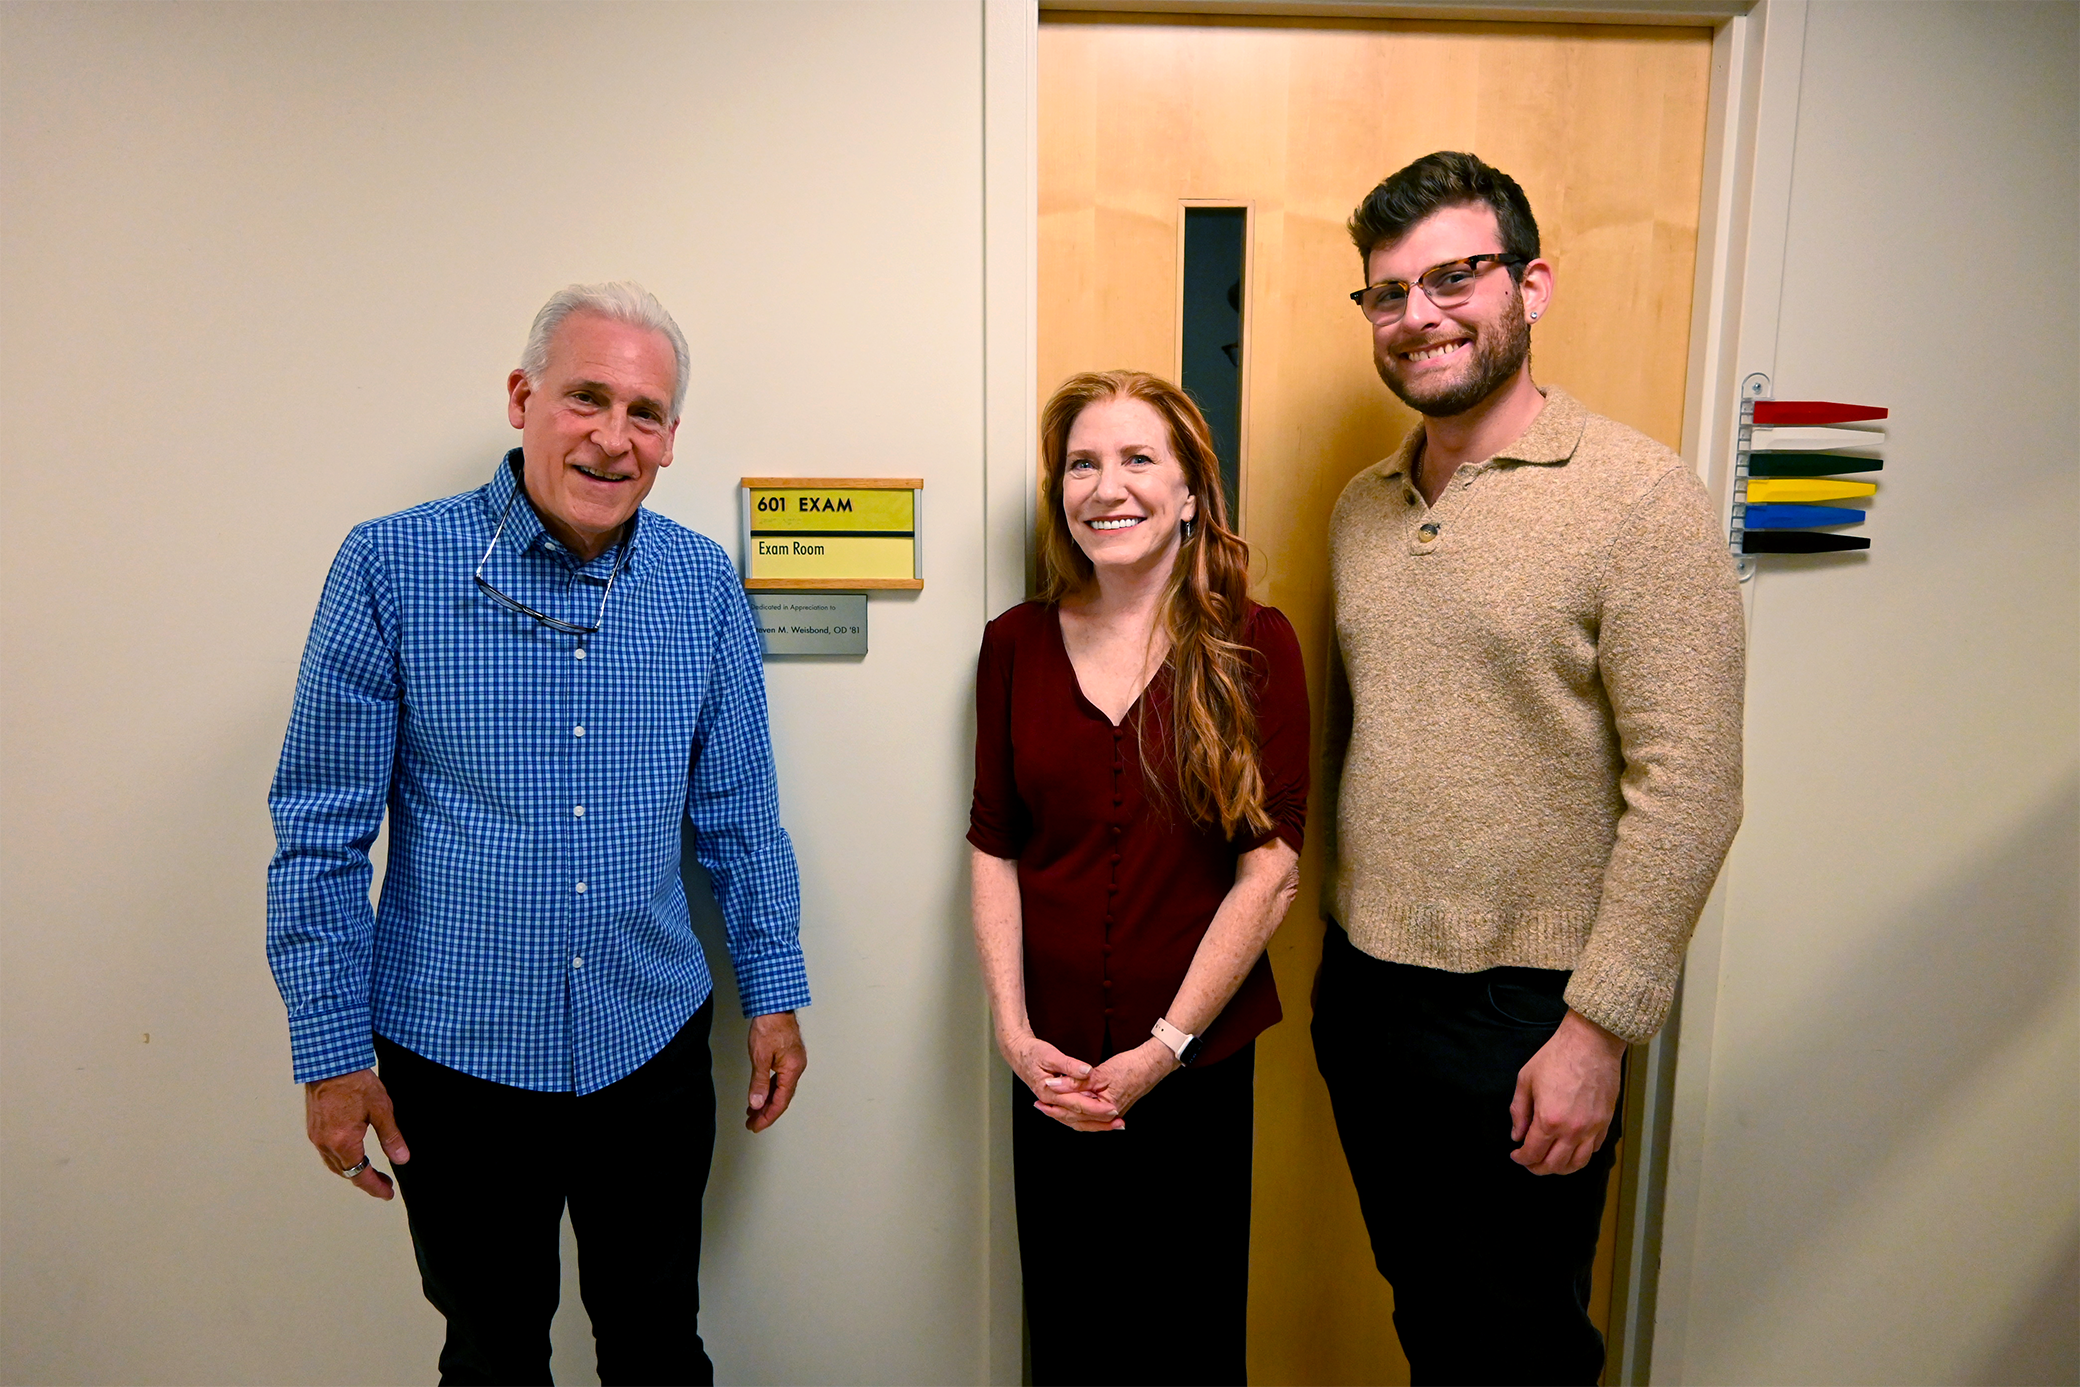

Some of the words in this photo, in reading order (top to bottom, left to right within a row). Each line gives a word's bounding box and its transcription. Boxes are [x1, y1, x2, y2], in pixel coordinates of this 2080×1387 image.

[757, 497, 786, 512] 601
[799, 497, 853, 512] EXAM
[758, 541, 789, 555] Exam
[793, 541, 825, 555] Room
[790, 604, 828, 612] Appreciation
[756, 626, 776, 634] teven
[778, 626, 789, 634] M.
[791, 626, 831, 635] Weisbond,
[833, 626, 847, 634] OD
[849, 626, 860, 634] '81
